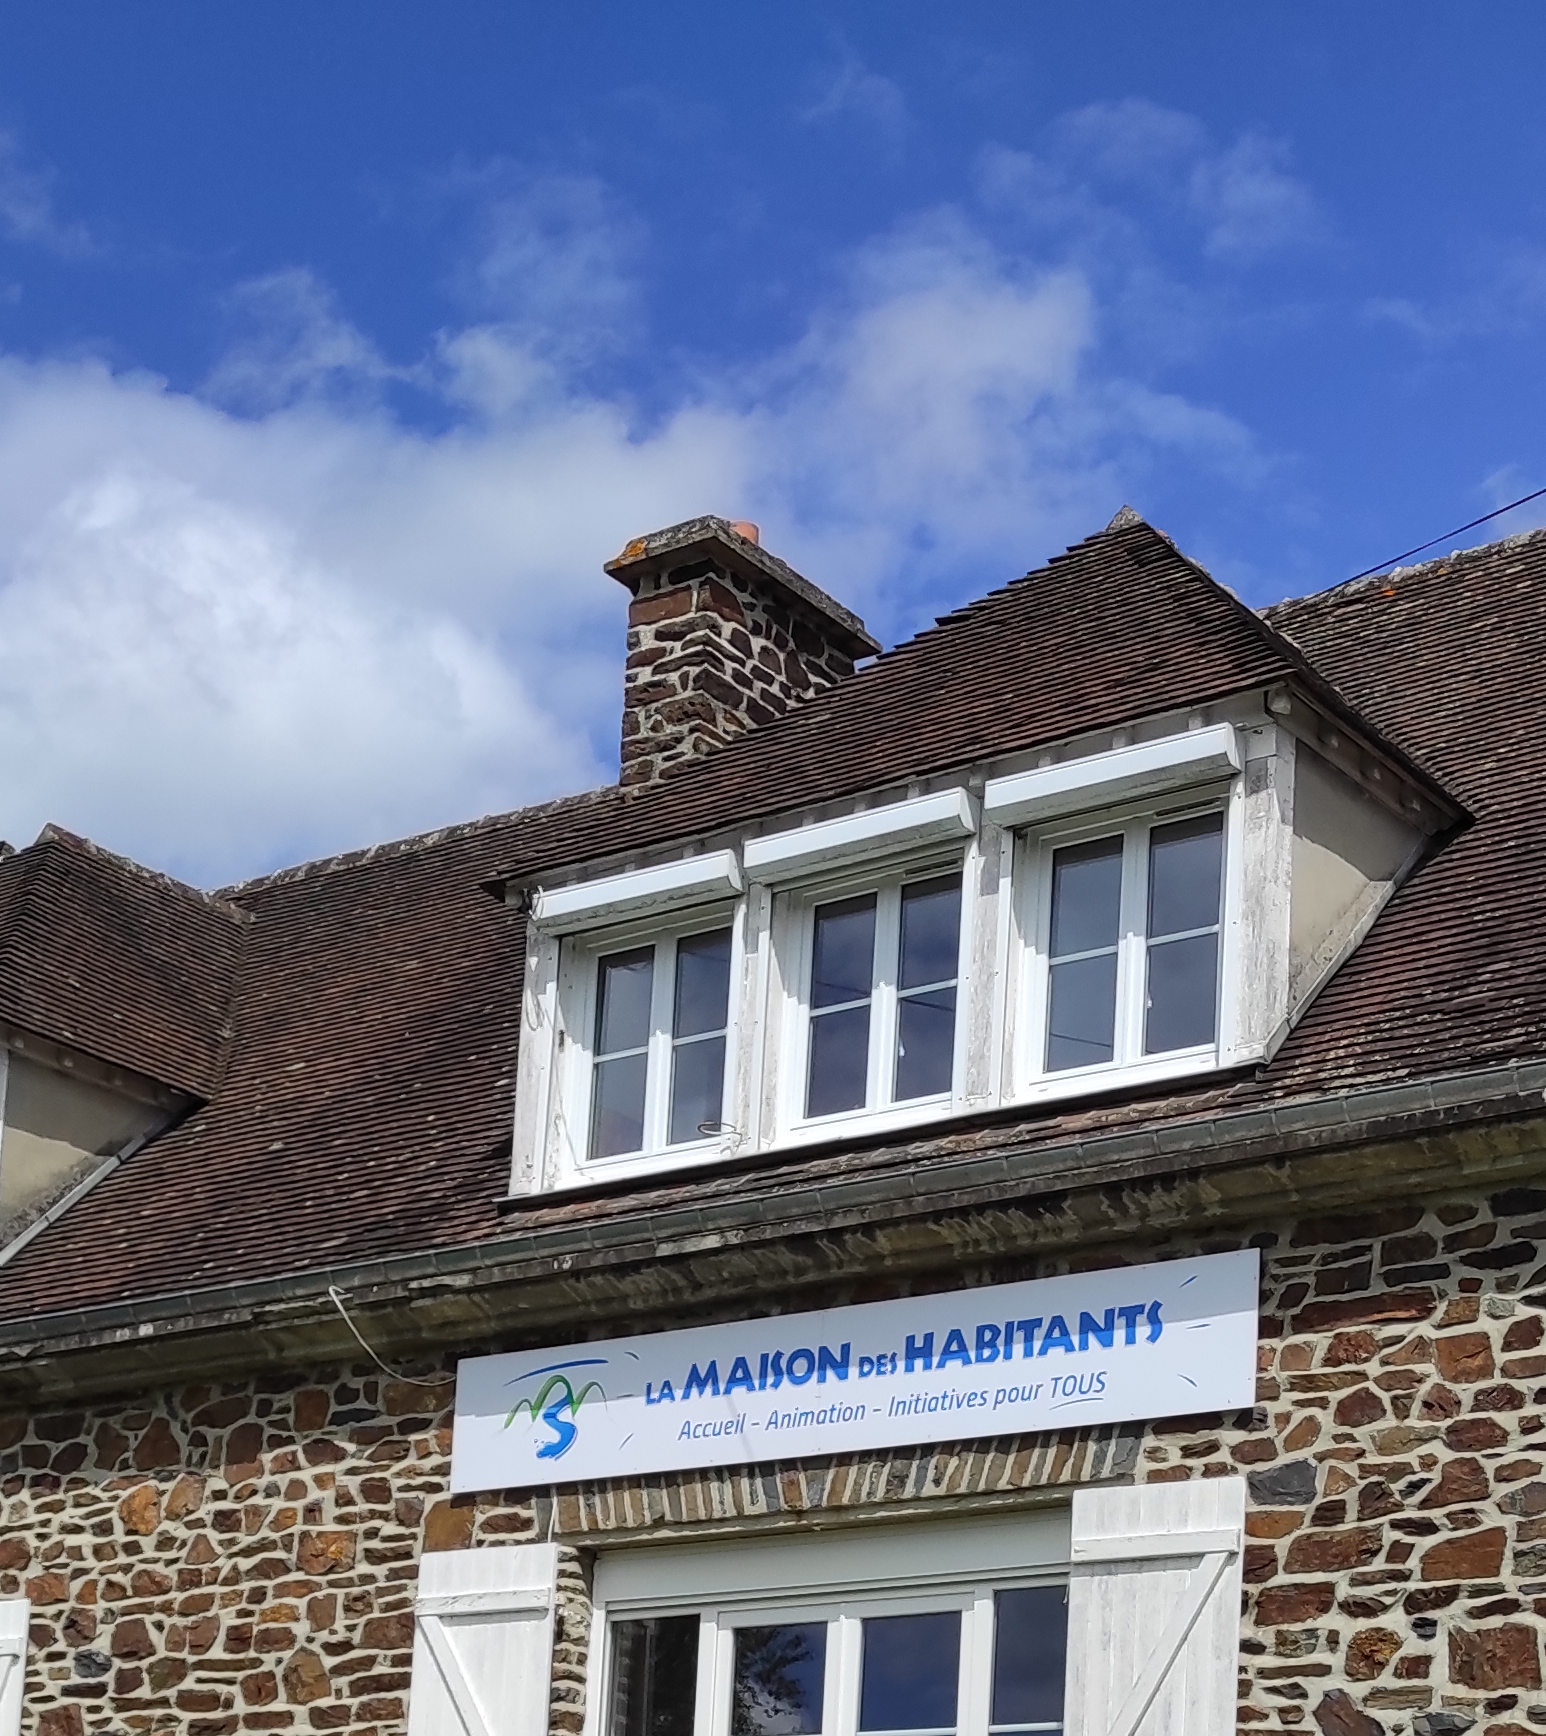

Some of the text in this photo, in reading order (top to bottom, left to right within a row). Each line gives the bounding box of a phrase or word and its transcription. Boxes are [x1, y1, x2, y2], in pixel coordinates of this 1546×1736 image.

[645, 1300, 1163, 1405] LA MAISON DES HABITANTS
[678, 1412, 747, 1441] Accueil
[765, 1401, 866, 1431] Animation
[888, 1388, 989, 1418] Initiatives
[993, 1382, 1044, 1412] pour
[1051, 1371, 1107, 1399] TOUS
